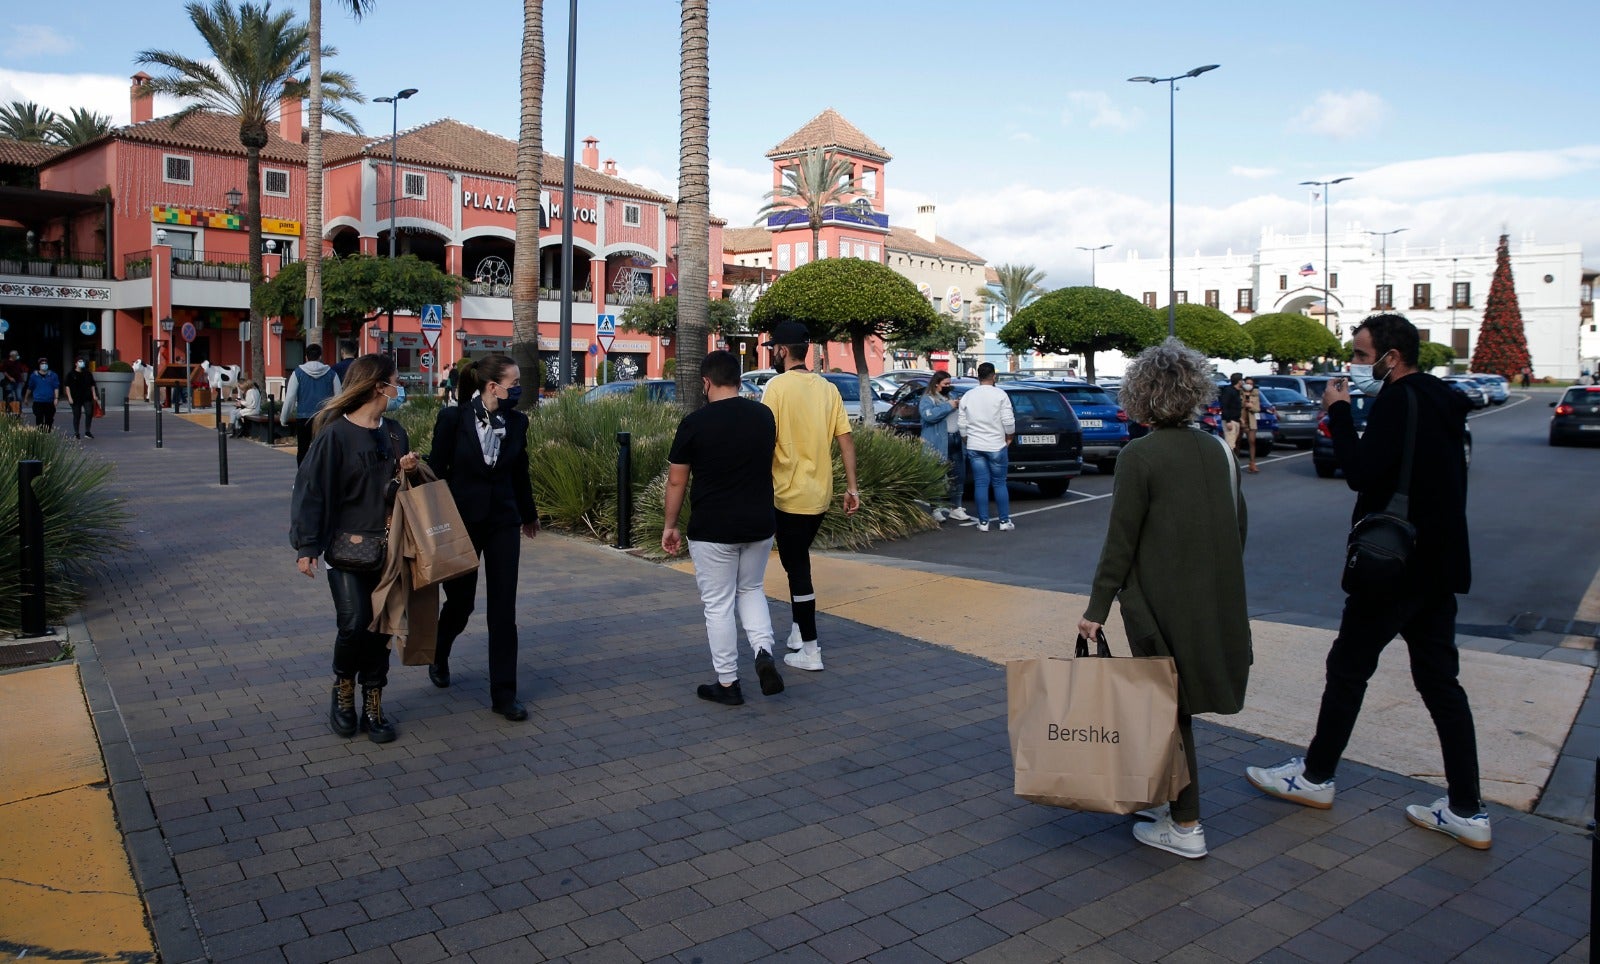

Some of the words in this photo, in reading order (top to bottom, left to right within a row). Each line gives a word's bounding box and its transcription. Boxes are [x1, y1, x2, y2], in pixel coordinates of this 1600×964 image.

[463, 190, 517, 213] PLAZA
[550, 203, 598, 224] MYOR
[1048, 723, 1121, 744] Bershka
